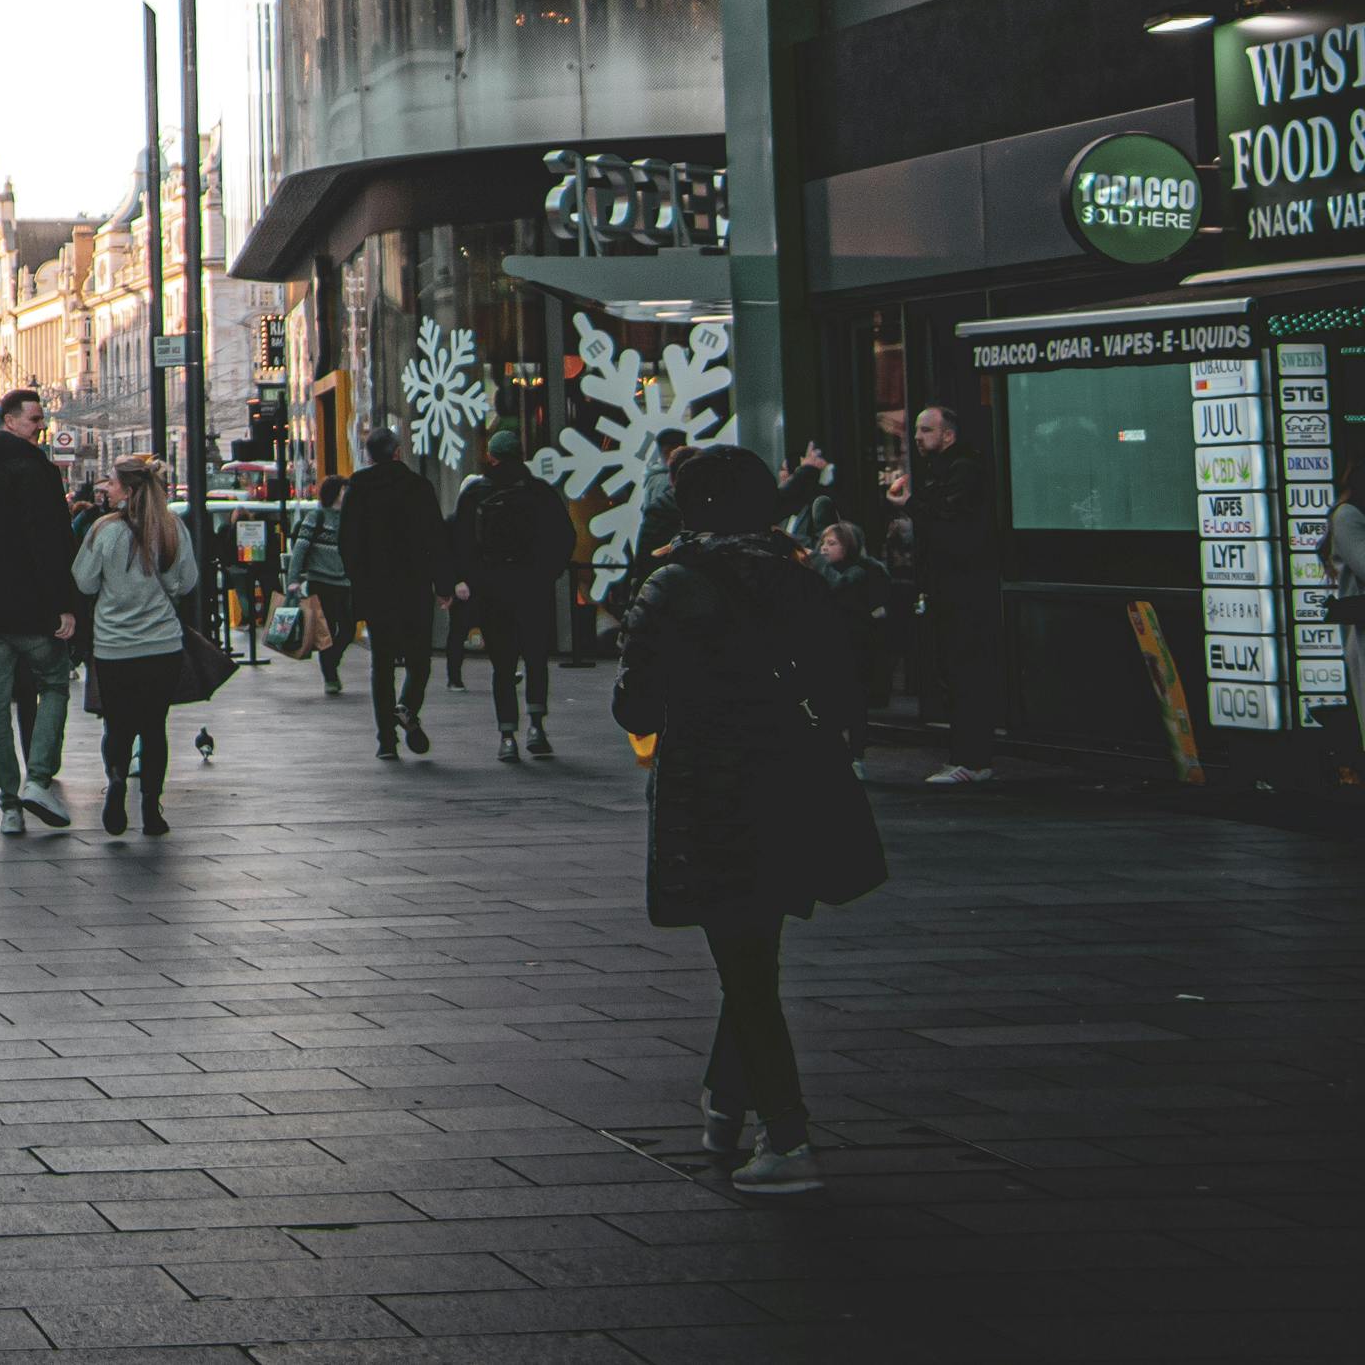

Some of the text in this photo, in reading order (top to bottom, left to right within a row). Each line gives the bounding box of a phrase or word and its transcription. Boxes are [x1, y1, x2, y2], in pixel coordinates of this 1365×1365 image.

[1229, 116, 1337, 190] FOOD
[1079, 171, 1196, 210] TOBACCO
[1081, 206, 1191, 230] SOLD HERE
[1248, 199, 1314, 240] SNACK
[973, 342, 1036, 368] TOBACCO
[1046, 336, 1092, 361] CIGAR
[1103, 332, 1153, 357] VAPES
[1281, 352, 1323, 368] SWEETS
[1195, 360, 1242, 376] TOBACCO
[1283, 387, 1324, 402] STIG
[1202, 403, 1242, 438] JUUL
[1212, 457, 1235, 483] CBD
[1287, 456, 1329, 471] DRINKS
[1209, 496, 1243, 517] VAPES
[1289, 489, 1333, 508] JUUL
[1203, 520, 1252, 534] E-LIQUIDS
[1296, 522, 1326, 535] VAPES
[1212, 545, 1246, 569] LYFT
[1296, 610, 1319, 618] GEEK
[1302, 630, 1334, 643] LYFT
[1210, 644, 1260, 673] ELUX
[1298, 668, 1342, 685] IQOS
[1217, 687, 1260, 721] IQOS
